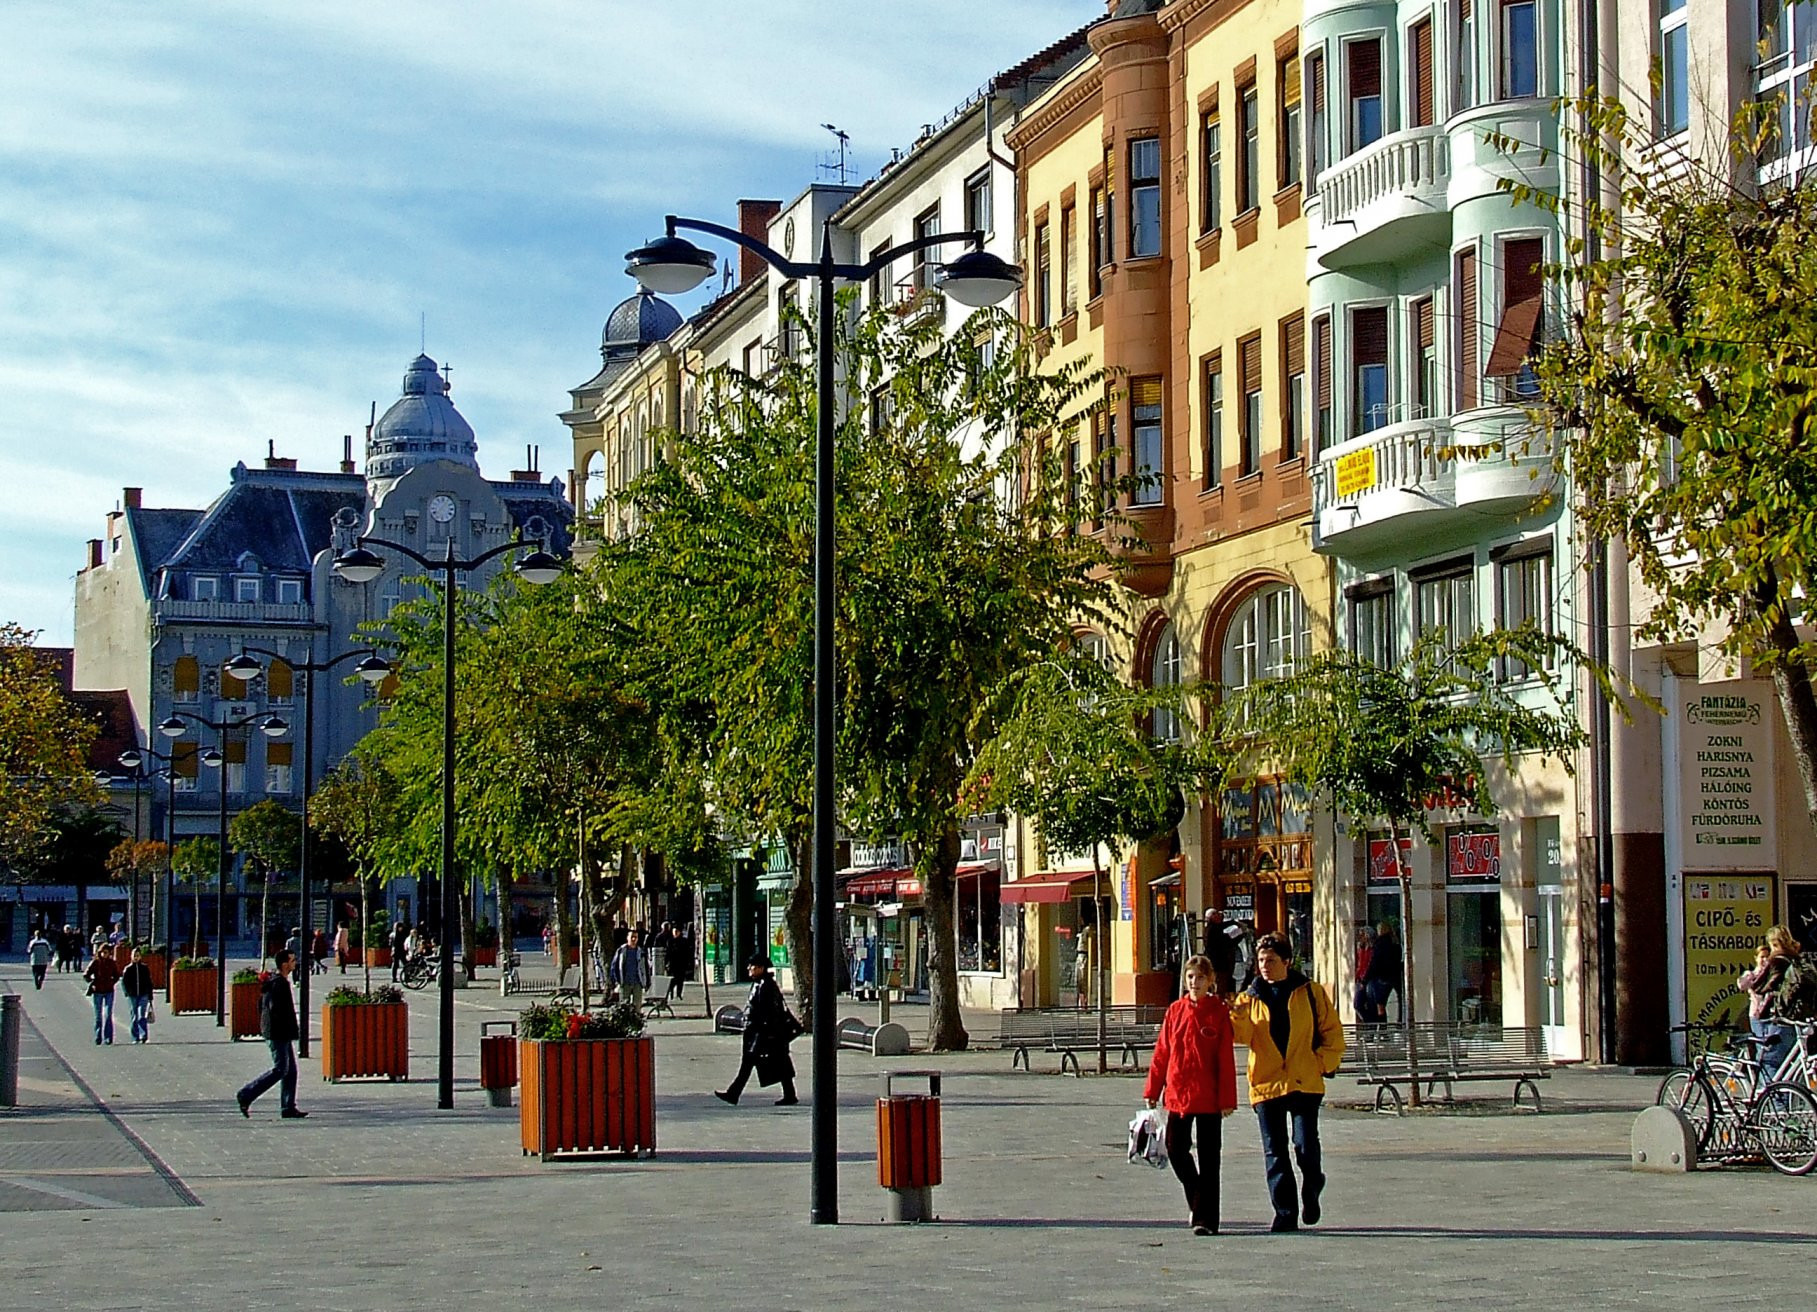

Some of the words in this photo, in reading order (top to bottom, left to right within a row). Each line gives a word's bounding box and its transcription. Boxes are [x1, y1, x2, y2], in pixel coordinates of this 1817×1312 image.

[1701, 695, 1747, 709] FANTÁZIA
[1707, 736, 1743, 747] ZOKNI
[1697, 751, 1754, 762] HARISNYA
[1701, 767, 1751, 778] PIZSAMA
[1701, 780, 1752, 794] HÁLÓING
[1703, 798, 1750, 810] KÖNTÖS
[1692, 813, 1762, 826] FÜRDŐRUHA
[1745, 910, 1762, 928] és
